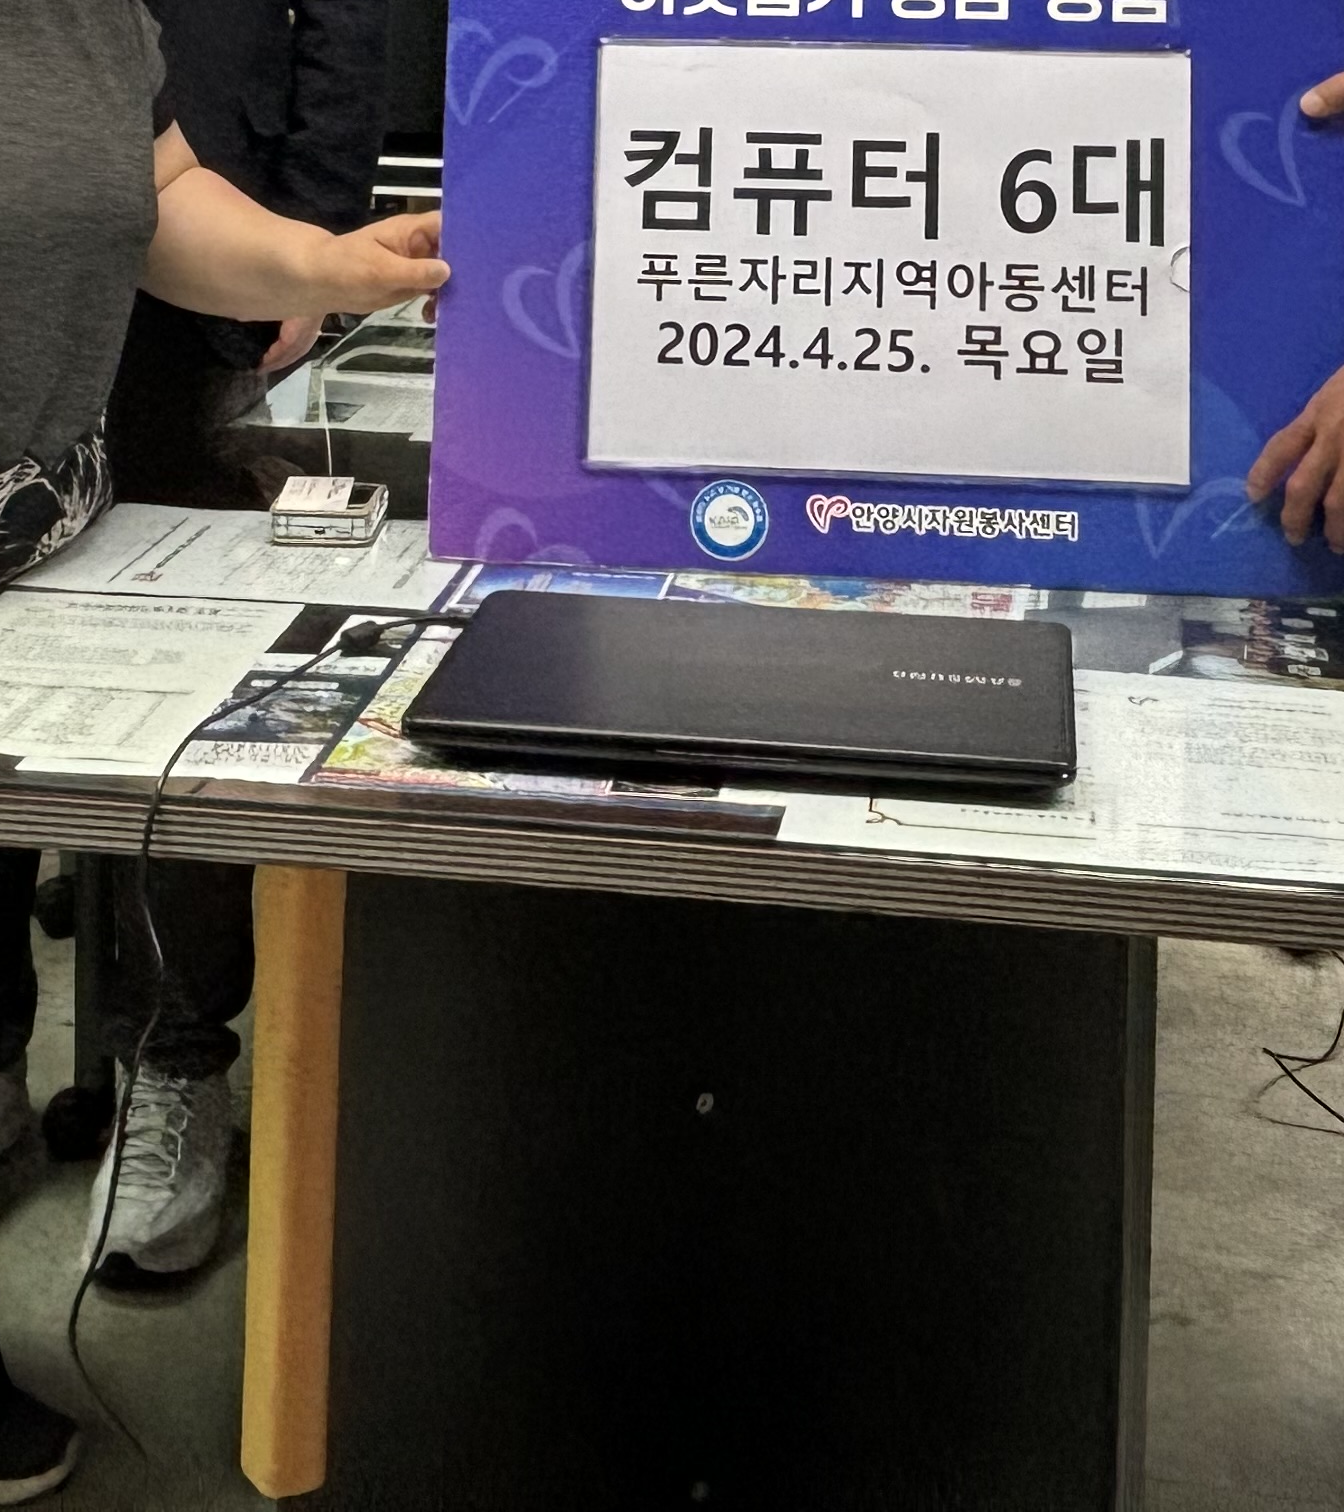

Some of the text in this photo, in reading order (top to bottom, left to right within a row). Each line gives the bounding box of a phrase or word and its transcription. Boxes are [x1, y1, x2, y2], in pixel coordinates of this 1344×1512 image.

[623, 126, 1165, 247] 컴퓨터 6대
[637, 253, 1149, 317] 푸른자리지역아동센터
[657, 321, 1125, 384] 2024.4.25. 목요일
[850, 501, 1079, 541] 안양시자원봉사센터
